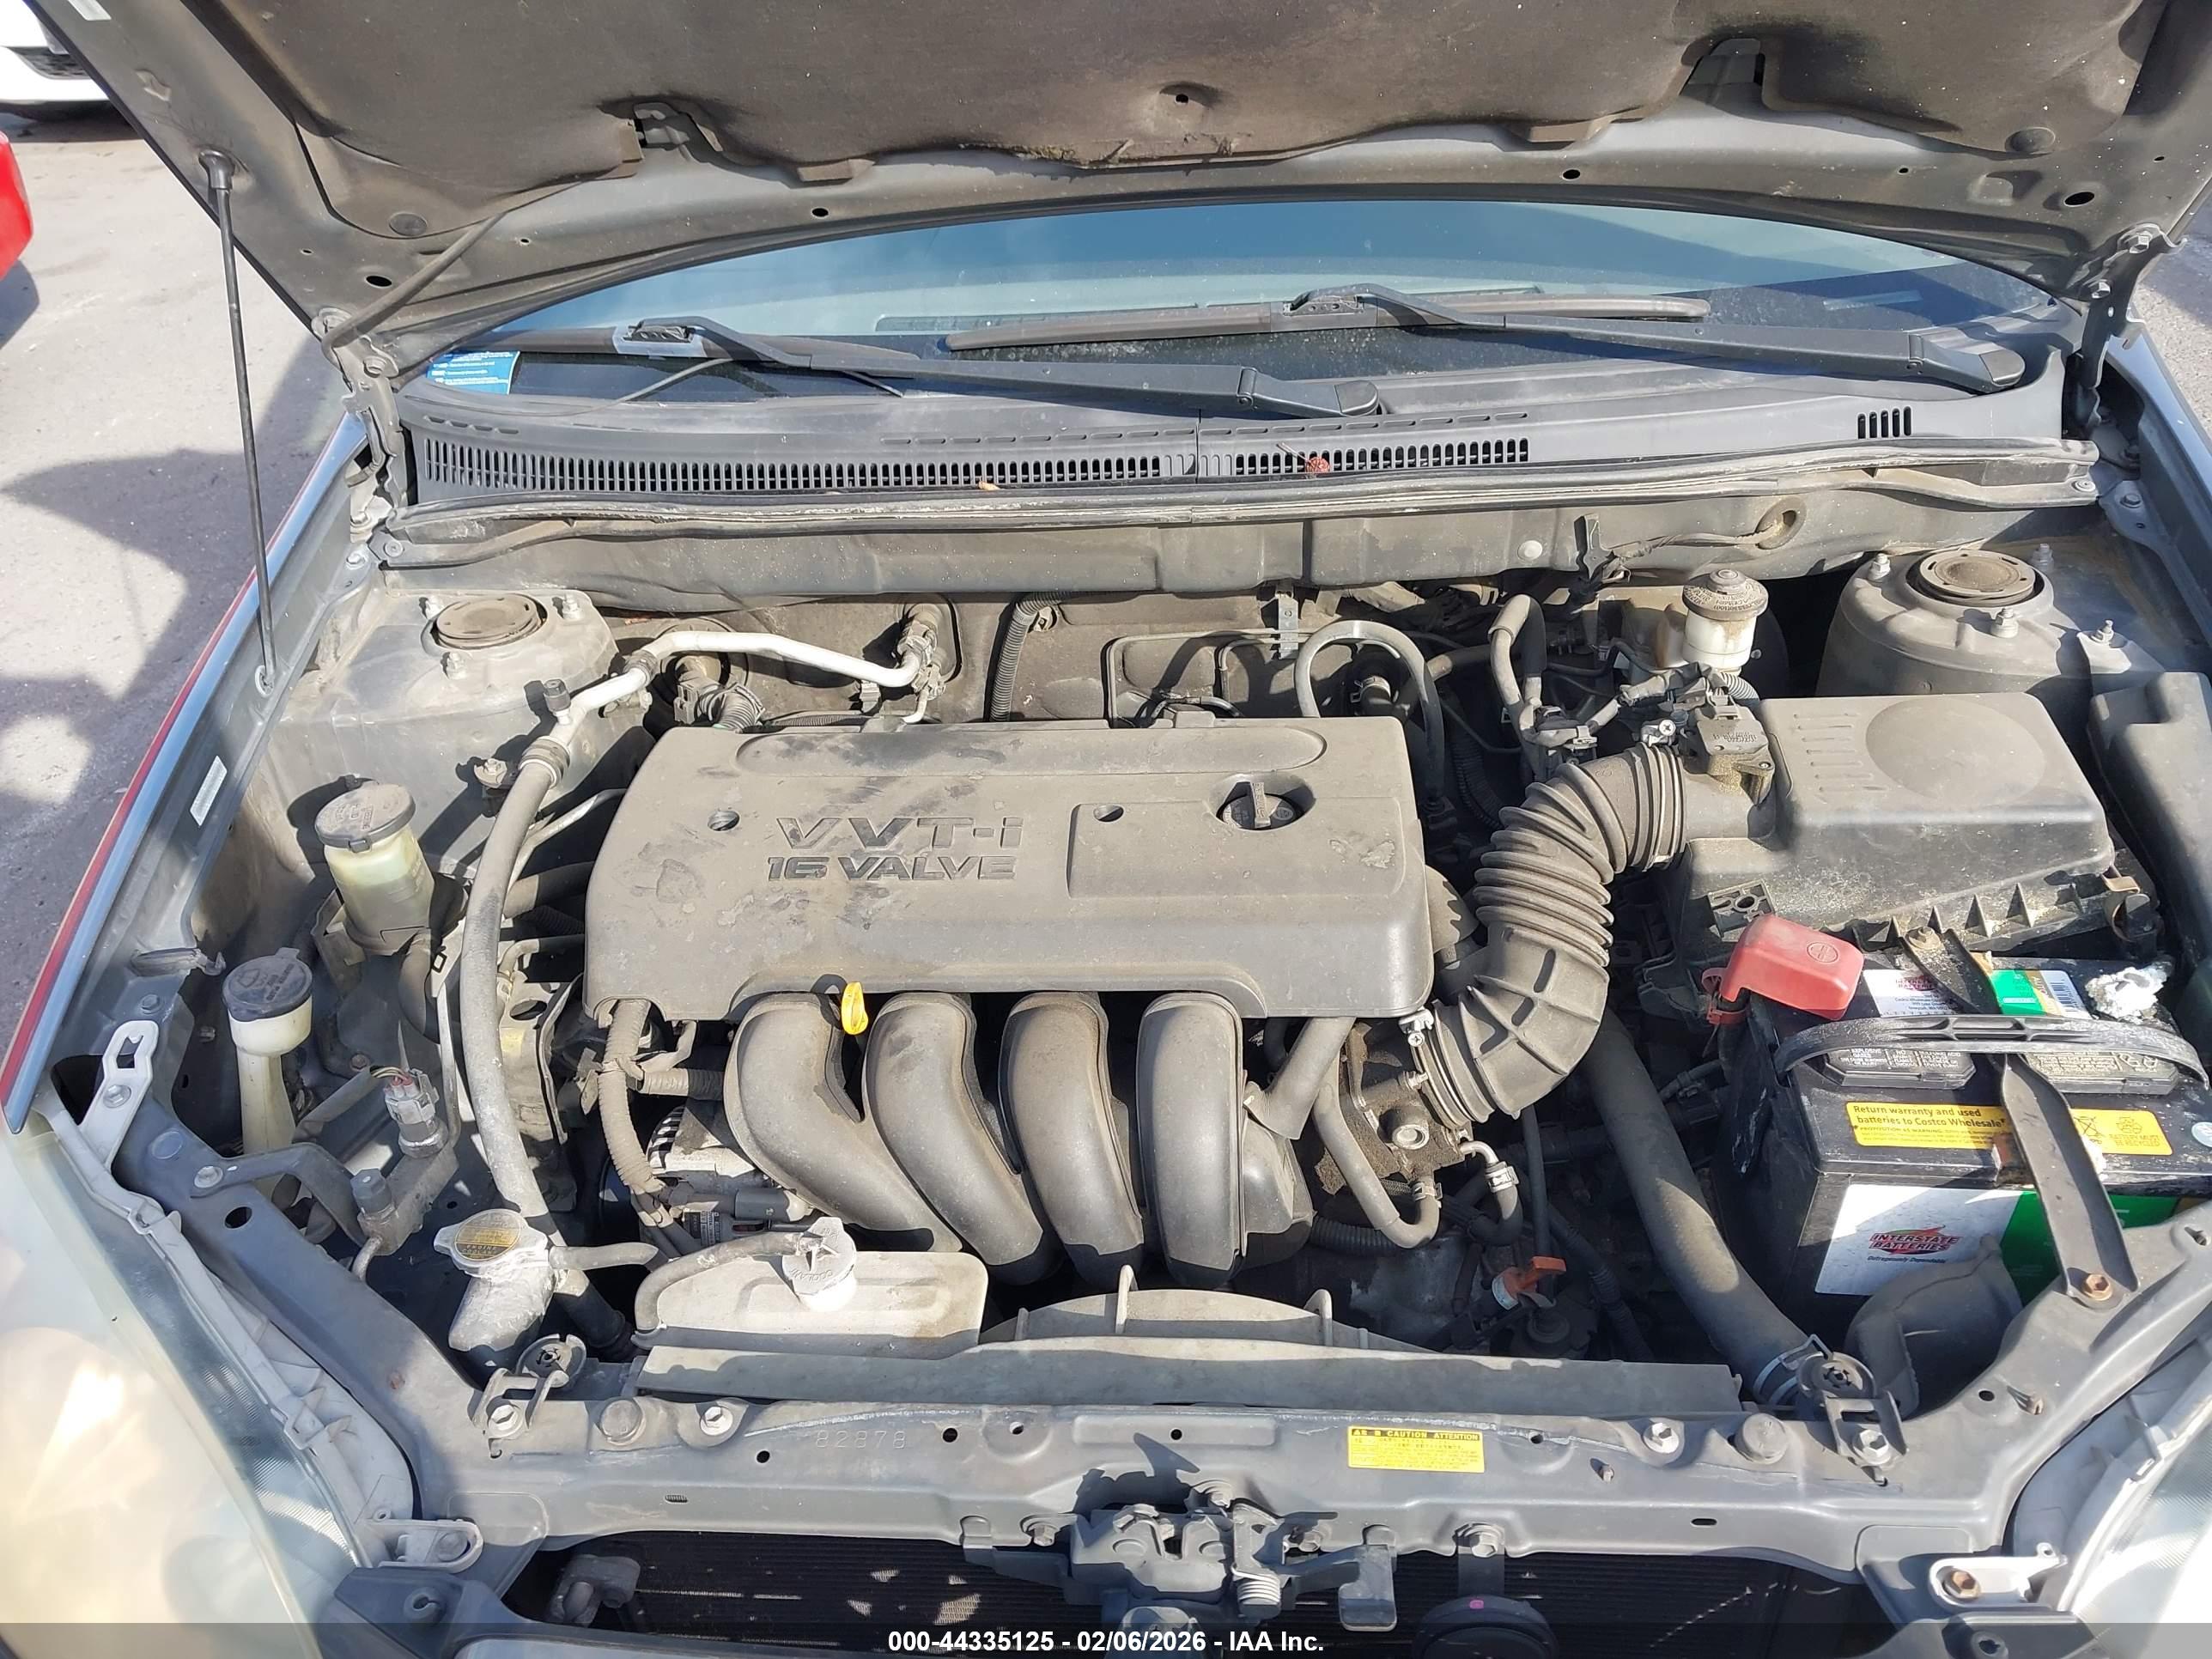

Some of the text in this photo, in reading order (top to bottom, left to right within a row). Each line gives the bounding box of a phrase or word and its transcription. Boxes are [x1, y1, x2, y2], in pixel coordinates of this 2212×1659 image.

[767, 855, 1018, 881] 16 VALVE
[1853, 1105, 1981, 1117] Return warranty and used
[1857, 1115, 1900, 1125] batteries
[1914, 1117, 1947, 1126] Costco
[1872, 1233, 1959, 1244] INTERSTATE
[1872, 1242, 1949, 1250] BATTERIES
[1387, 1430, 1428, 1439] CAUTION
[1433, 1431, 1479, 1441] ATTENTION
